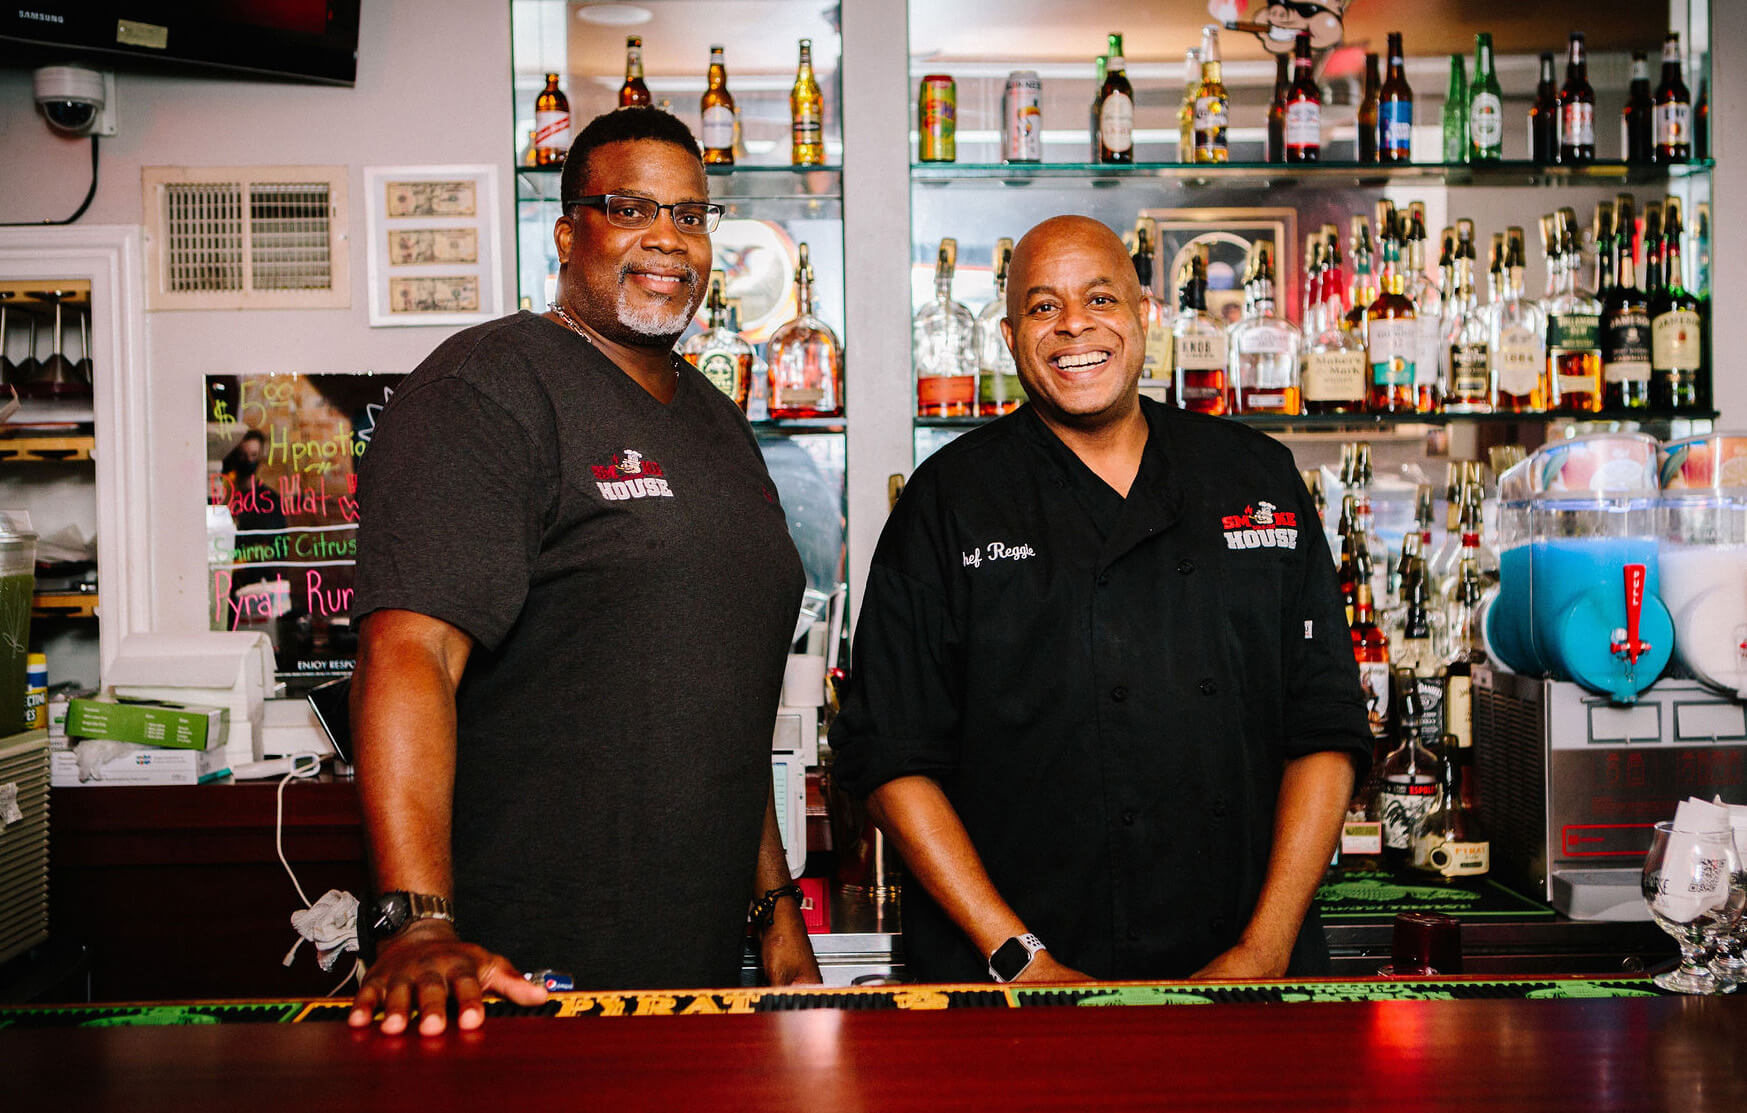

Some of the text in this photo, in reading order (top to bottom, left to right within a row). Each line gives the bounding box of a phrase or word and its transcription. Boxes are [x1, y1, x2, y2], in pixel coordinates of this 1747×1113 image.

[19, 10, 64, 23] SAMSUNG
[596, 478, 674, 501] HOUSE
[1221, 511, 1298, 530] SMKE
[295, 532, 357, 558] Citrus
[1223, 528, 1298, 550] HOUSE
[962, 547, 983, 568] hef
[1632, 570, 1641, 607] PULL
[214, 570, 291, 632] Pyrat
[298, 660, 357, 670] ENJOY RESPO
[554, 993, 761, 1017] PYRAT
